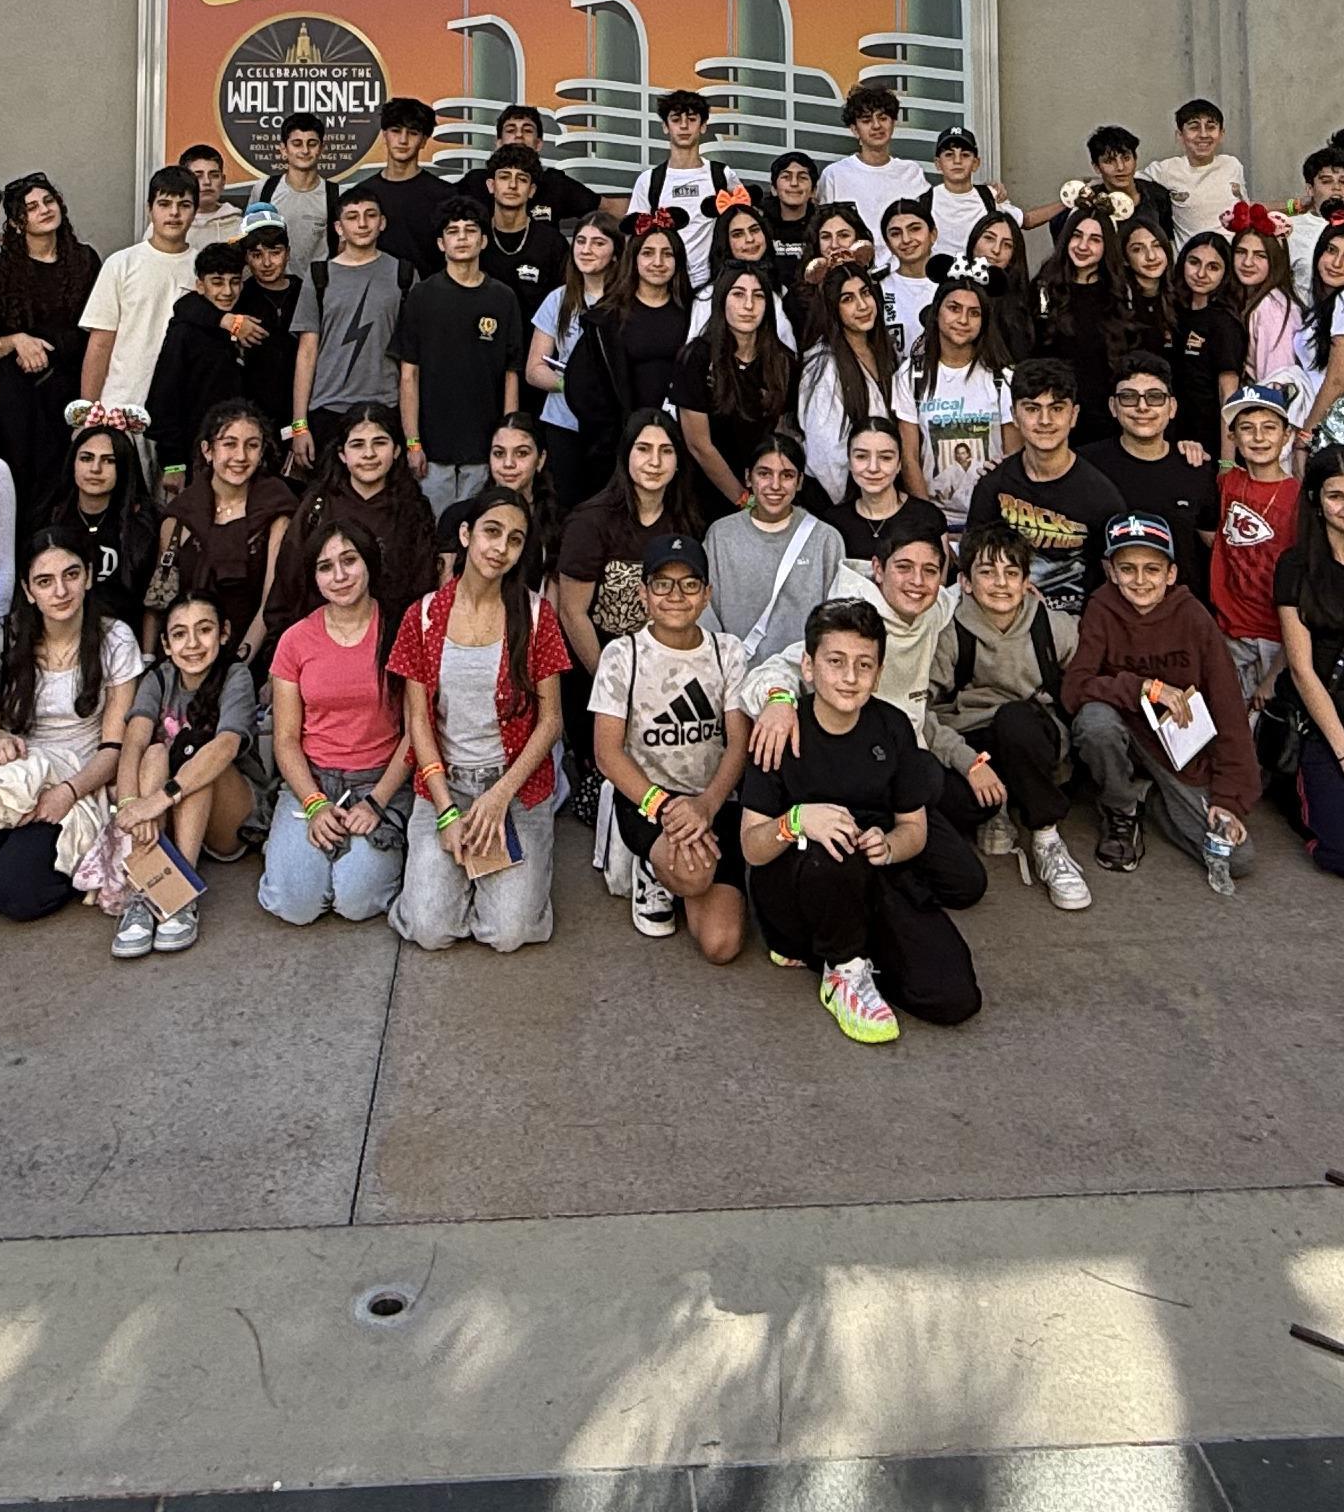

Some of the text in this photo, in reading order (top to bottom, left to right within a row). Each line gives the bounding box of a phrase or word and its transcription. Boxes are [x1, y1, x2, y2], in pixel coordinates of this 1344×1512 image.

[235, 67, 372, 78] A CELEBRATION OF THE
[227, 80, 381, 113] WALT DISNEY
[259, 115, 347, 129] CONY
[643, 720, 722, 747] adidas
